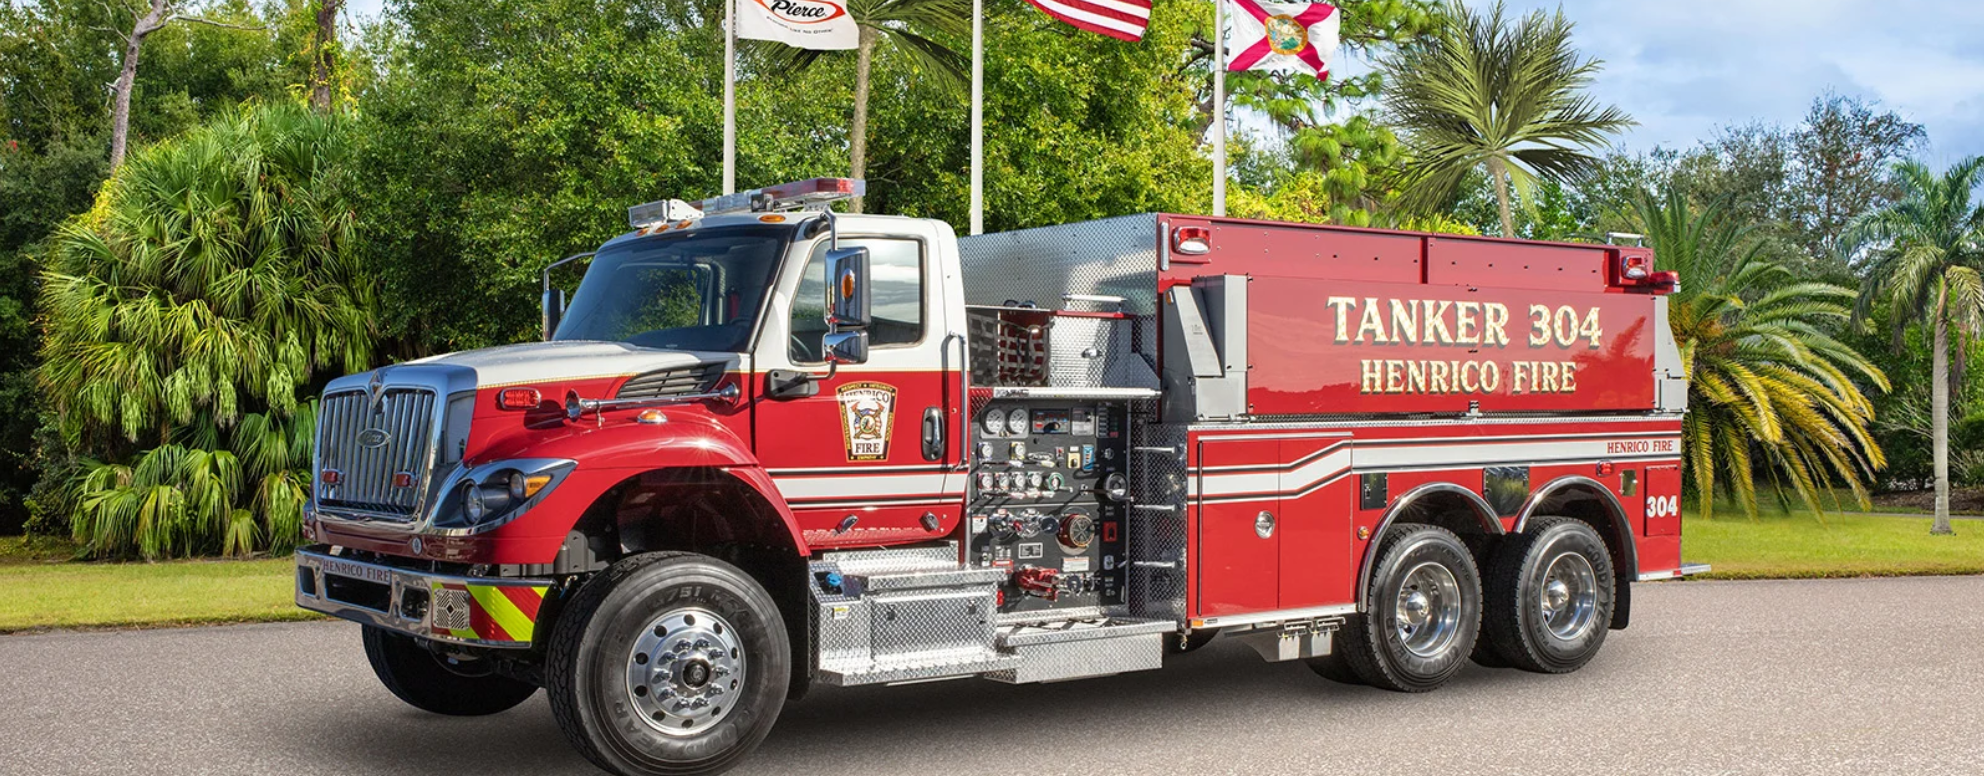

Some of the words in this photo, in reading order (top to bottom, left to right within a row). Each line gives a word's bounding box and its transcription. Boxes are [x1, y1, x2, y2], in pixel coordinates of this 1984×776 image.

[771, 0, 826, 17] Pierce
[1326, 296, 1510, 346] TANKER
[1528, 304, 1603, 348] 304
[1360, 359, 1499, 394] HENRICO
[1512, 360, 1577, 393] FIRE
[855, 442, 880, 454] FIRE
[1607, 440, 1649, 454] HENRICO
[1653, 440, 1673, 452] FIRE
[1646, 495, 1678, 518] 304
[323, 559, 363, 577] HENRICO
[366, 568, 390, 583] FIRE
